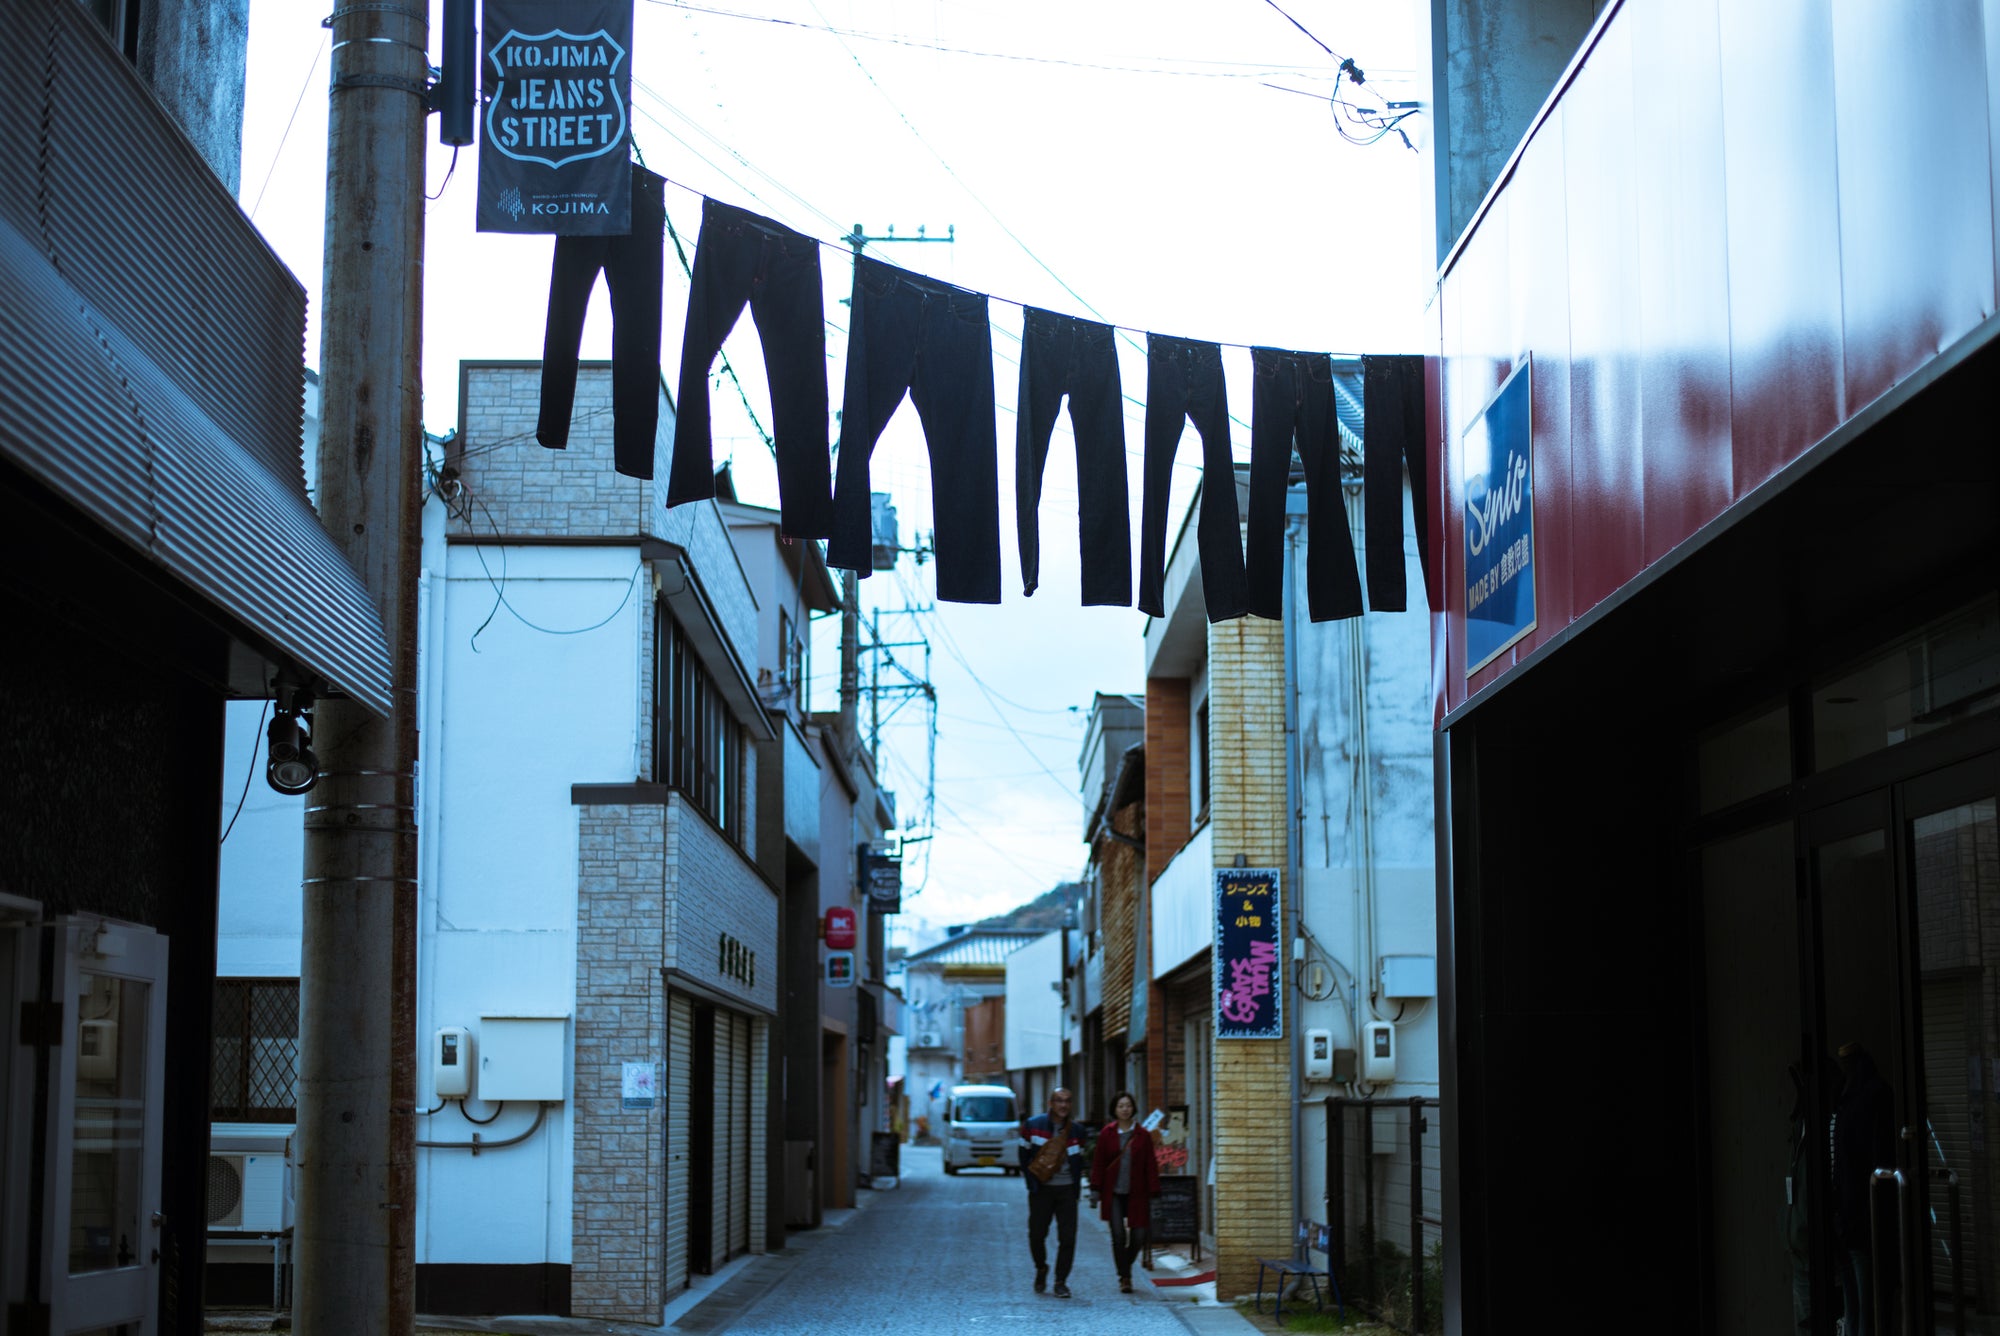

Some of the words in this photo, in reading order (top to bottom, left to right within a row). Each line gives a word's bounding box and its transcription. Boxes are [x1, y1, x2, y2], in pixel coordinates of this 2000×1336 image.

[506, 45, 609, 67] KOJIMA
[510, 78, 605, 110] JEANS
[500, 113, 614, 147] STREET
[531, 202, 610, 215] KOJIMA
[1468, 573, 1489, 612] MADE
[1489, 562, 1500, 595] BY
[1227, 883, 1268, 895] ジーンズ
